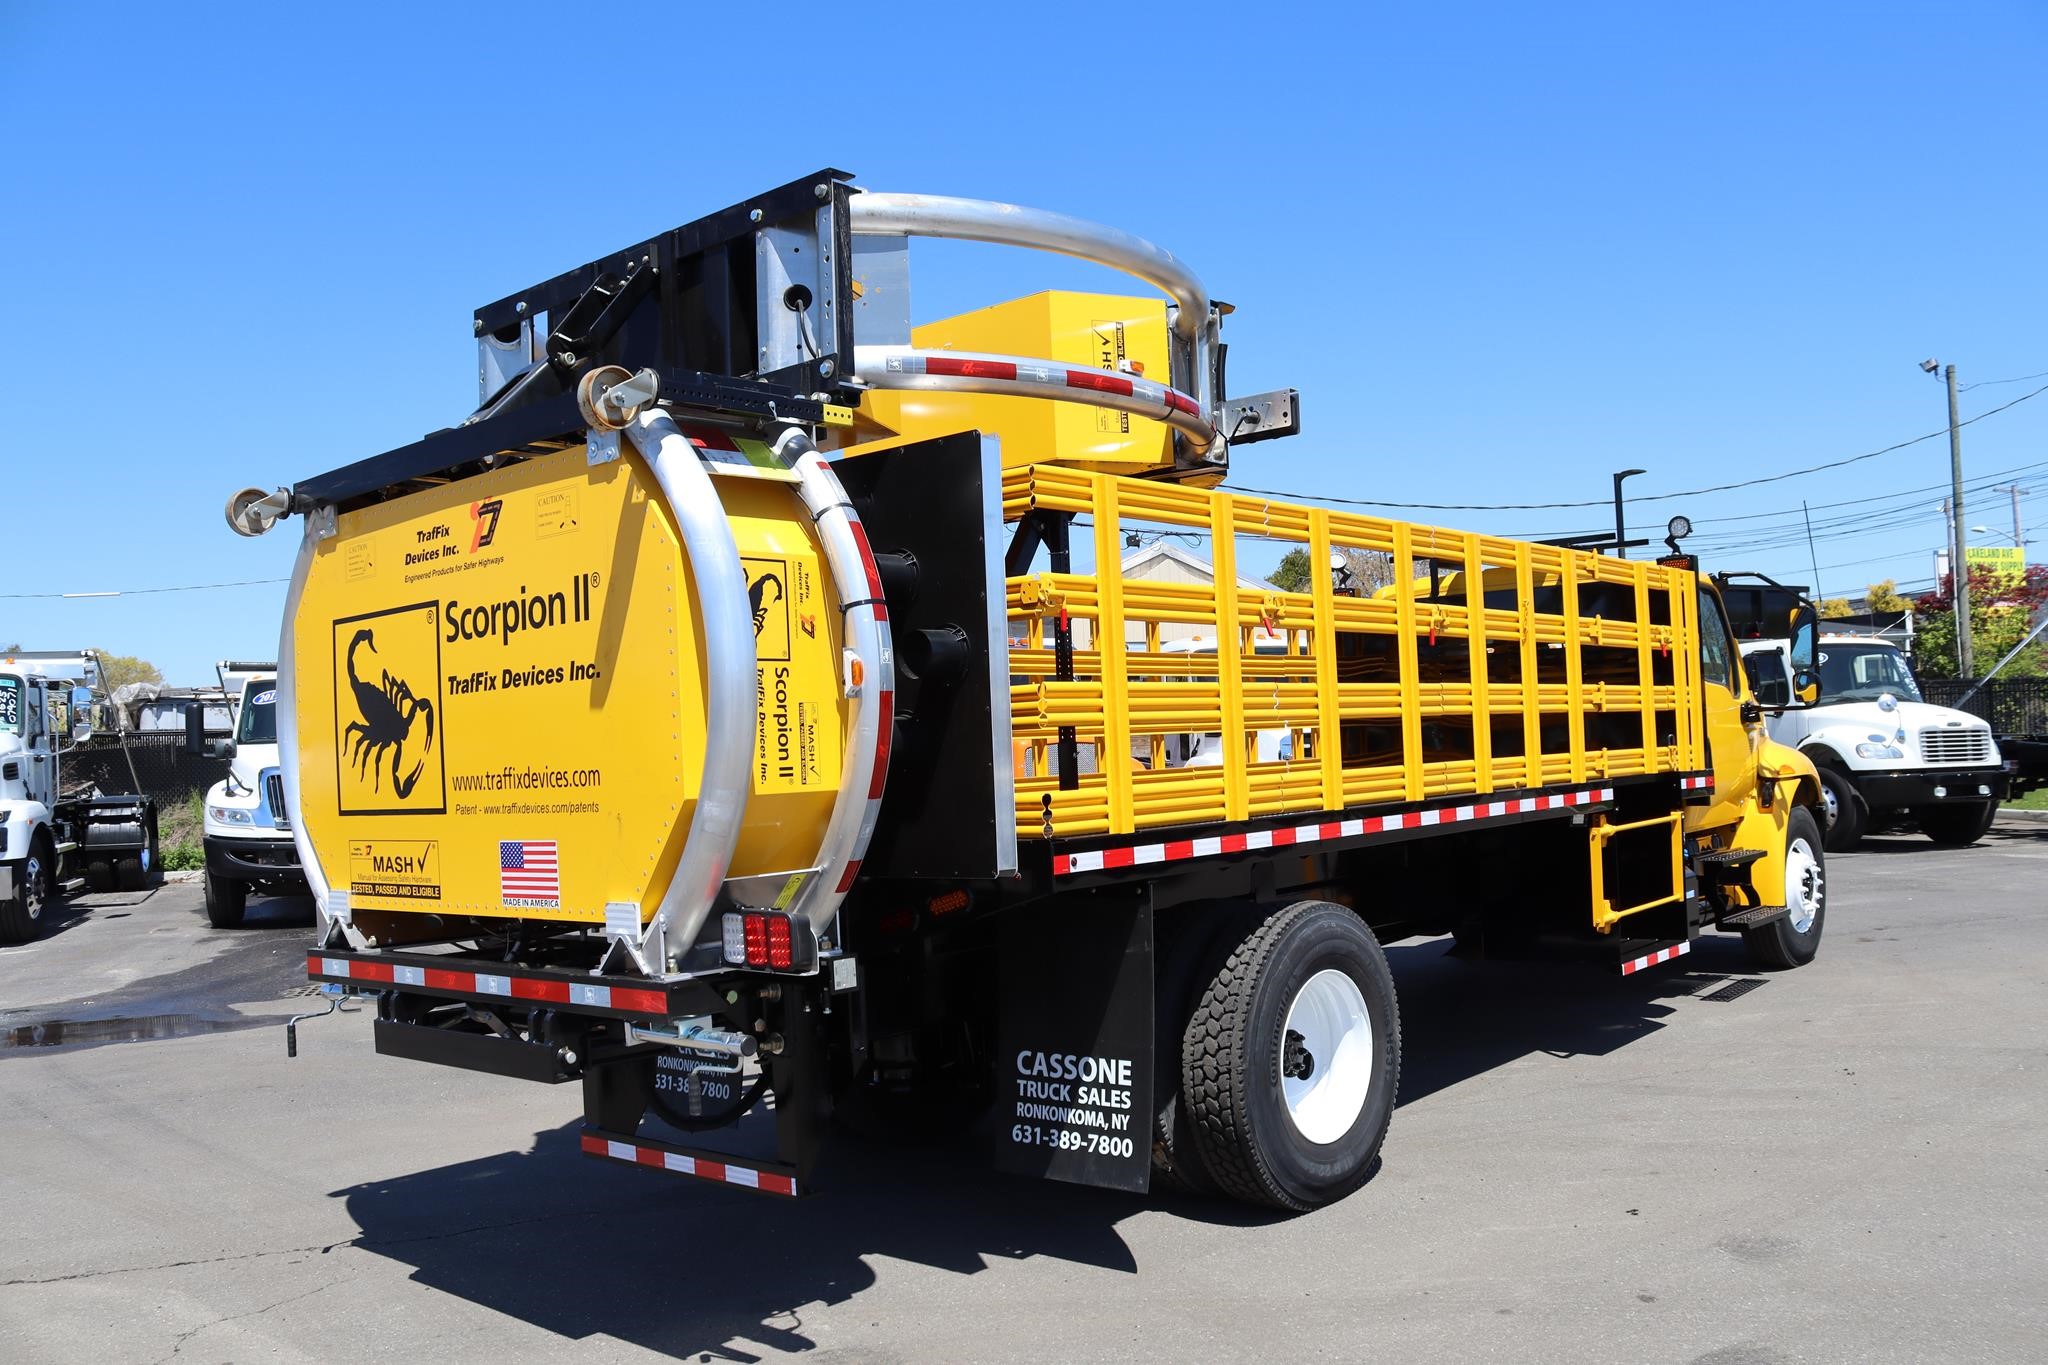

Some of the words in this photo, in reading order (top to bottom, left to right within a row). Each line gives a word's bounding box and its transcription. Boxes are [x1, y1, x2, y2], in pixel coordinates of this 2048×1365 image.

[1103, 352, 1112, 370] SH
[416, 524, 450, 543] TrafFix
[405, 549, 439, 566] Devices
[442, 544, 460, 557] Inc.
[404, 571, 432, 583] Engineered
[432, 566, 454, 577] Products
[455, 564, 463, 572] for
[463, 561, 478, 571] Safer
[478, 556, 504, 568] Highways
[445, 585, 566, 646] Scorpion
[448, 671, 497, 695] TrafFix
[501, 664, 564, 689] Devices
[569, 660, 601, 681] Inc.
[757, 668, 765, 708] TrafFix
[773, 667, 792, 761] Scorpion
[759, 711, 767, 759] Devices
[452, 765, 600, 792] www.traffixdevices.com
[455, 803, 477, 815] Patent
[483, 801, 599, 816] www.traffixdevices.com/patents
[373, 855, 414, 873] MASH
[375, 884, 398, 895] PASSED
[398, 886, 412, 896] AND
[412, 887, 440, 897] ELIGIBLE
[502, 898, 521, 906] MADE
[530, 899, 559, 907] AMERICA
[1017, 1050, 1132, 1086] CASSONE
[1017, 1079, 1071, 1102] TRUCK
[1078, 1086, 1131, 1109] SALES
[1017, 1102, 1109, 1131] RONKONKOMA,
[1112, 1113, 1130, 1131] NY
[1012, 1124, 1133, 1158] 631-389-7800
